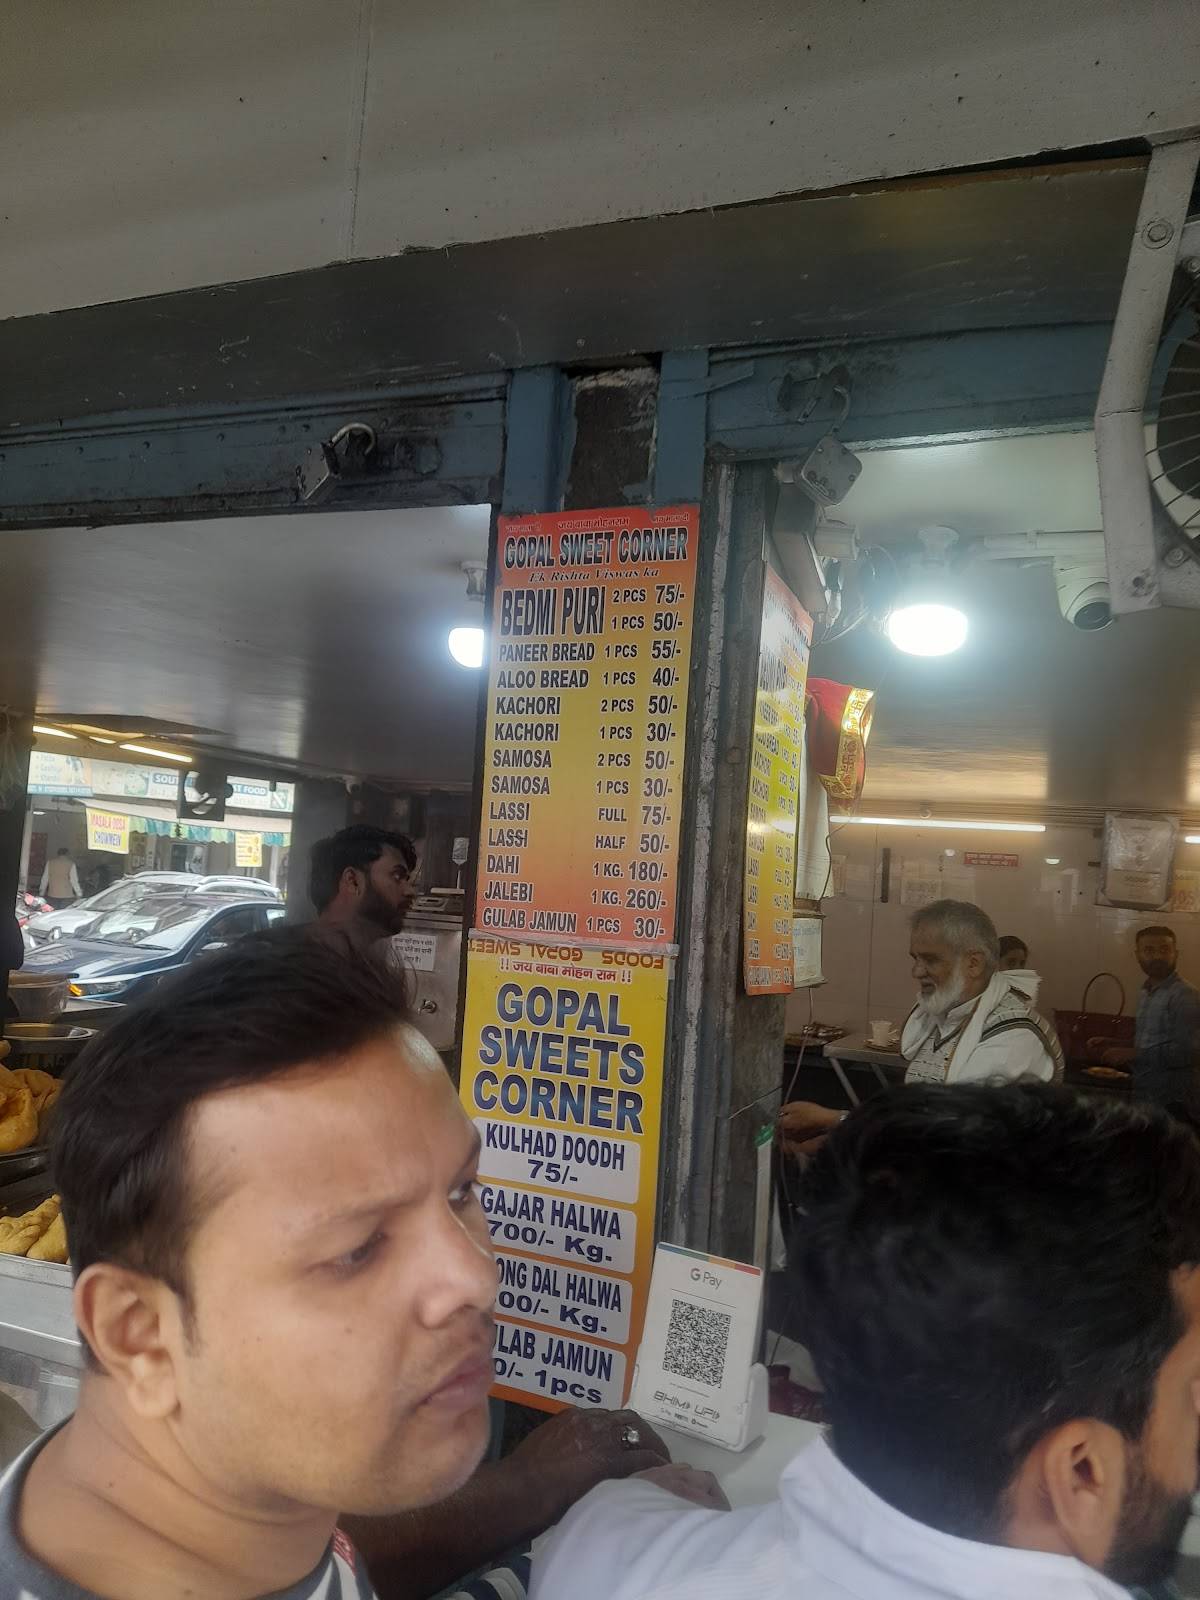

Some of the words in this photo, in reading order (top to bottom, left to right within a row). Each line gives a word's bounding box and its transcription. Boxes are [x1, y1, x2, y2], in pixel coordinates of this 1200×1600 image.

[505, 536, 555, 569] GOPAL
[560, 532, 614, 566] SWEET
[618, 528, 688, 563] CORNER
[529, 572, 545, 582] Ek
[551, 570, 590, 581] Rishta
[596, 569, 639, 580] Viswas
[643, 567, 659, 577] ka
[613, 591, 620, 603] 2
[623, 589, 646, 602] PCS
[655, 584, 684, 604] 75/-
[501, 589, 556, 636] BEDMI
[562, 586, 606, 635] PURI
[611, 616, 617, 629] 1
[621, 616, 645, 629] PCS
[653, 612, 683, 631] 50/-
[500, 643, 548, 662] PANEER
[552, 642, 594, 661] BREAD
[605, 645, 611, 657] 1
[615, 645, 637, 657] PCS
[652, 640, 681, 659] 55/-
[497, 670, 536, 688] ALOO
[540, 670, 589, 688] BREAD
[603, 673, 609, 684] 1
[613, 672, 636, 685] PCS
[652, 667, 679, 686] 40/-
[496, 696, 560, 715] KACHORI
[601, 700, 608, 712] 2
[612, 699, 634, 712] PCS
[648, 695, 678, 714] 50/-
[495, 723, 559, 741] KACHORI
[600, 727, 605, 739] 1
[610, 726, 632, 739] PCS
[646, 722, 676, 742] 30/-
[493, 750, 552, 768] SAMOSA
[598, 754, 604, 766] 2
[608, 753, 630, 767] PCS
[644, 750, 674, 769] 50/-
[243, 787, 266, 795] FOOD
[491, 776, 550, 794] SAMOSA
[596, 781, 602, 793] 1
[606, 781, 629, 794] PCS
[643, 778, 672, 797] 30/-
[490, 802, 530, 820] LASSI
[599, 808, 627, 822] FULL
[642, 805, 671, 825] 75/-
[488, 829, 528, 847] LASSI
[595, 836, 626, 849] HALF
[640, 834, 669, 853] 50/-
[487, 855, 520, 874] DAHI
[593, 863, 599, 876] 1
[603, 863, 623, 877] KG.
[629, 861, 668, 882] 180/-
[484, 881, 533, 901] JALEBI
[592, 891, 597, 904] 1
[601, 891, 621, 905] KG.
[626, 889, 666, 910] 260/-
[483, 908, 525, 929] GULAB
[530, 913, 577, 932] JAMUN
[586, 918, 592, 931] 1
[597, 918, 620, 933] PCS
[634, 918, 664, 938] 30/-
[530, 943, 583, 961] GOPAL
[602, 951, 664, 969] FOODS
[512, 961, 532, 972] जय
[562, 963, 593, 978] मोहन
[597, 970, 617, 982] राम
[496, 983, 631, 1036] GOPAL
[479, 1025, 644, 1085] SWEETS
[473, 1070, 643, 1135] CORNER
[486, 1123, 557, 1157] KULHAD
[562, 1135, 625, 1171] DOODH
[528, 1159, 578, 1184] 75/-
[480, 1187, 544, 1224] GAJAR
[551, 1201, 621, 1240] HALWA
[488, 1220, 554, 1246] 700/-
[564, 1235, 612, 1264] Kg.
[532, 1266, 560, 1297] DAL
[566, 1273, 622, 1313] HALWA
[690, 1268, 700, 1281] G
[703, 1271, 722, 1289] Pay
[498, 1291, 549, 1315] 00/-
[559, 1304, 608, 1334] Kg.
[541, 1337, 612, 1382] JAMUN
[654, 1391, 686, 1410] BHIM
